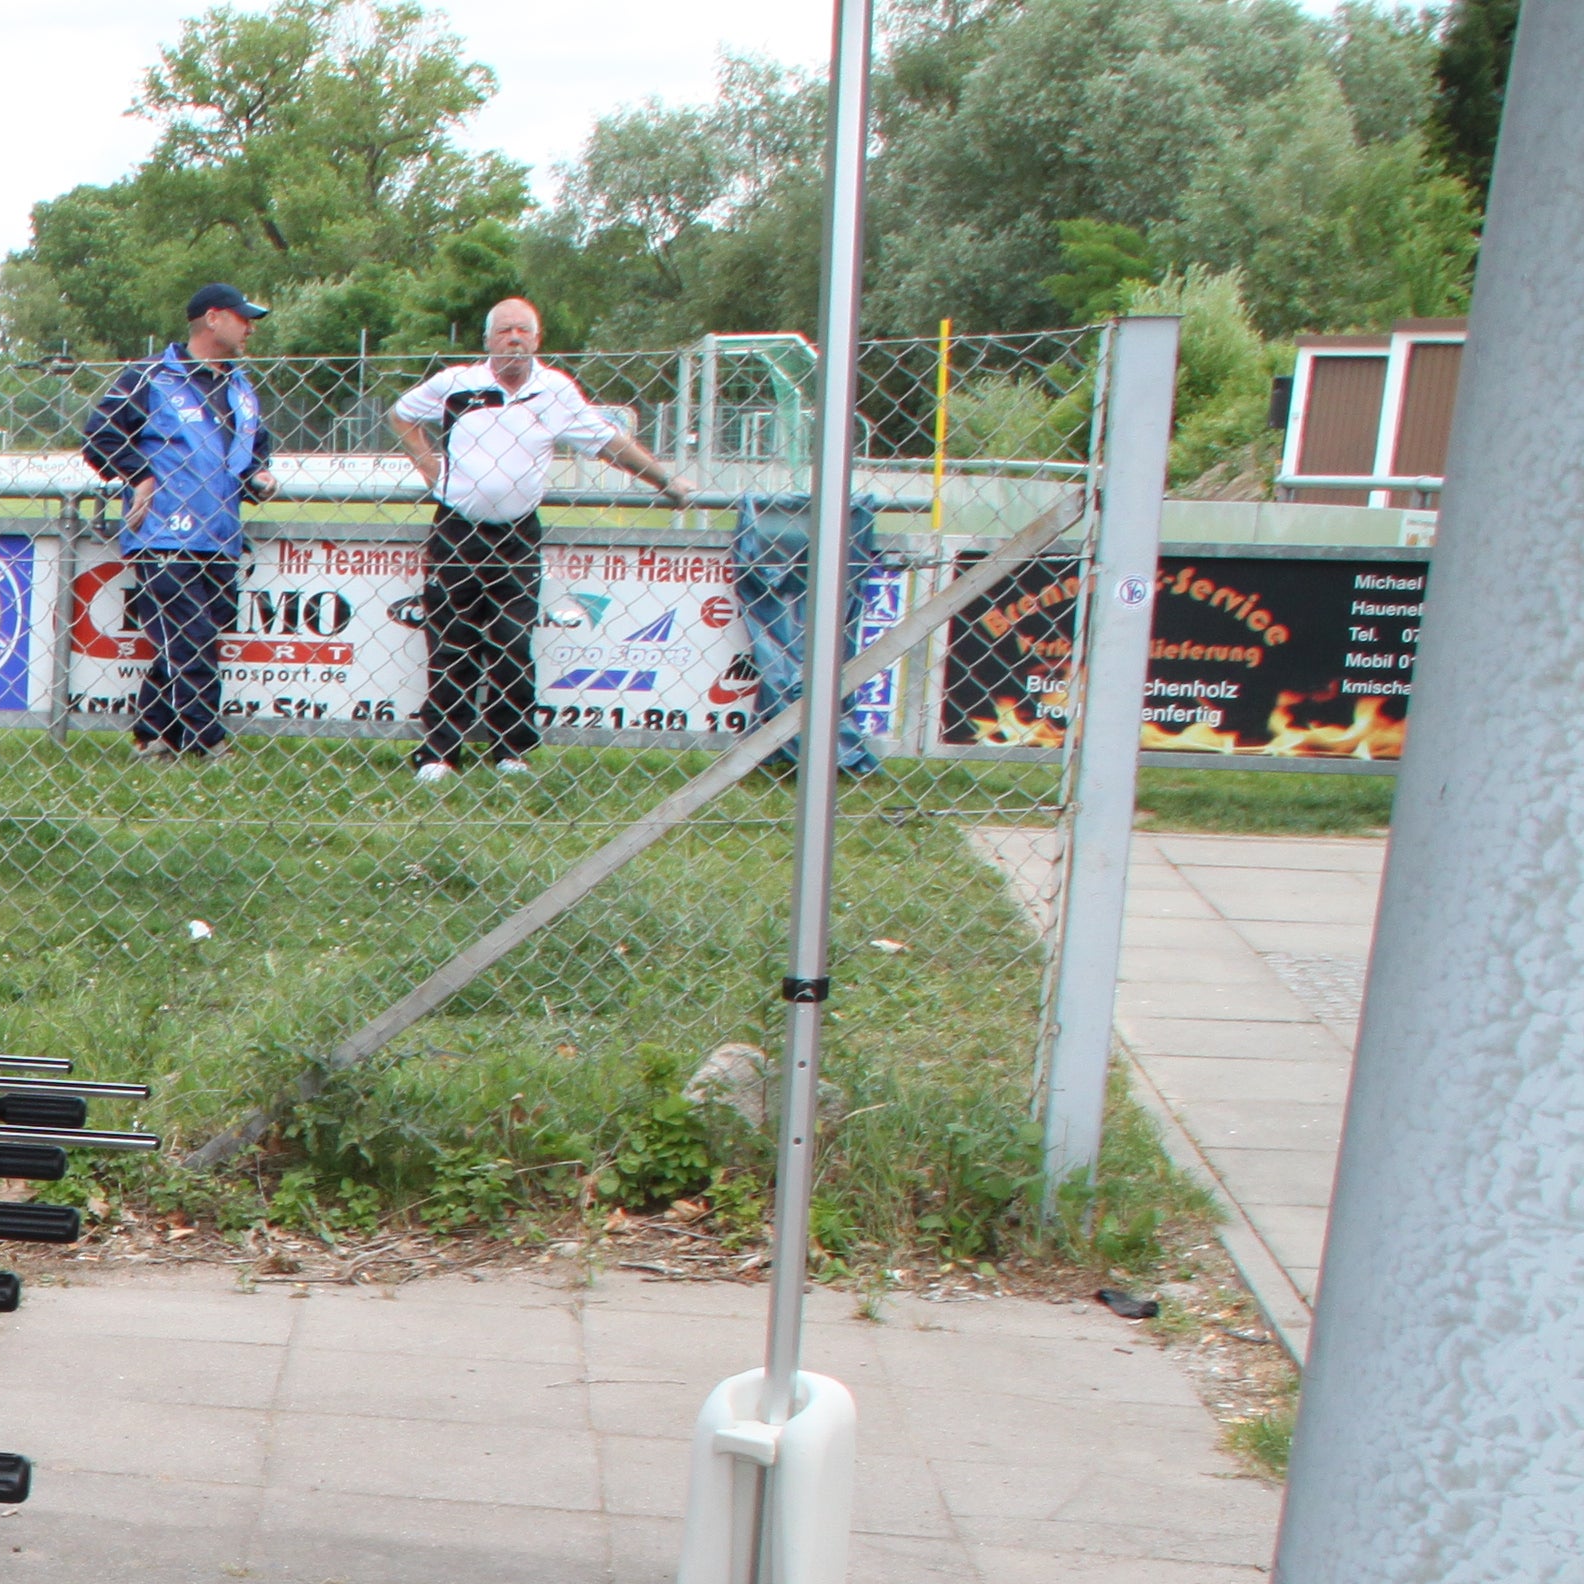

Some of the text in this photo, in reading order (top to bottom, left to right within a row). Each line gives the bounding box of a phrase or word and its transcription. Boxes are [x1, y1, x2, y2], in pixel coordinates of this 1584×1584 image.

[169, 513, 193, 532] 36
[278, 541, 313, 576] Ihr
[603, 551, 627, 581] in
[1353, 574, 1423, 591] Michael
[1348, 626, 1379, 642] Tel.
[117, 640, 348, 662] SORT
[1344, 652, 1393, 669] Mobil
